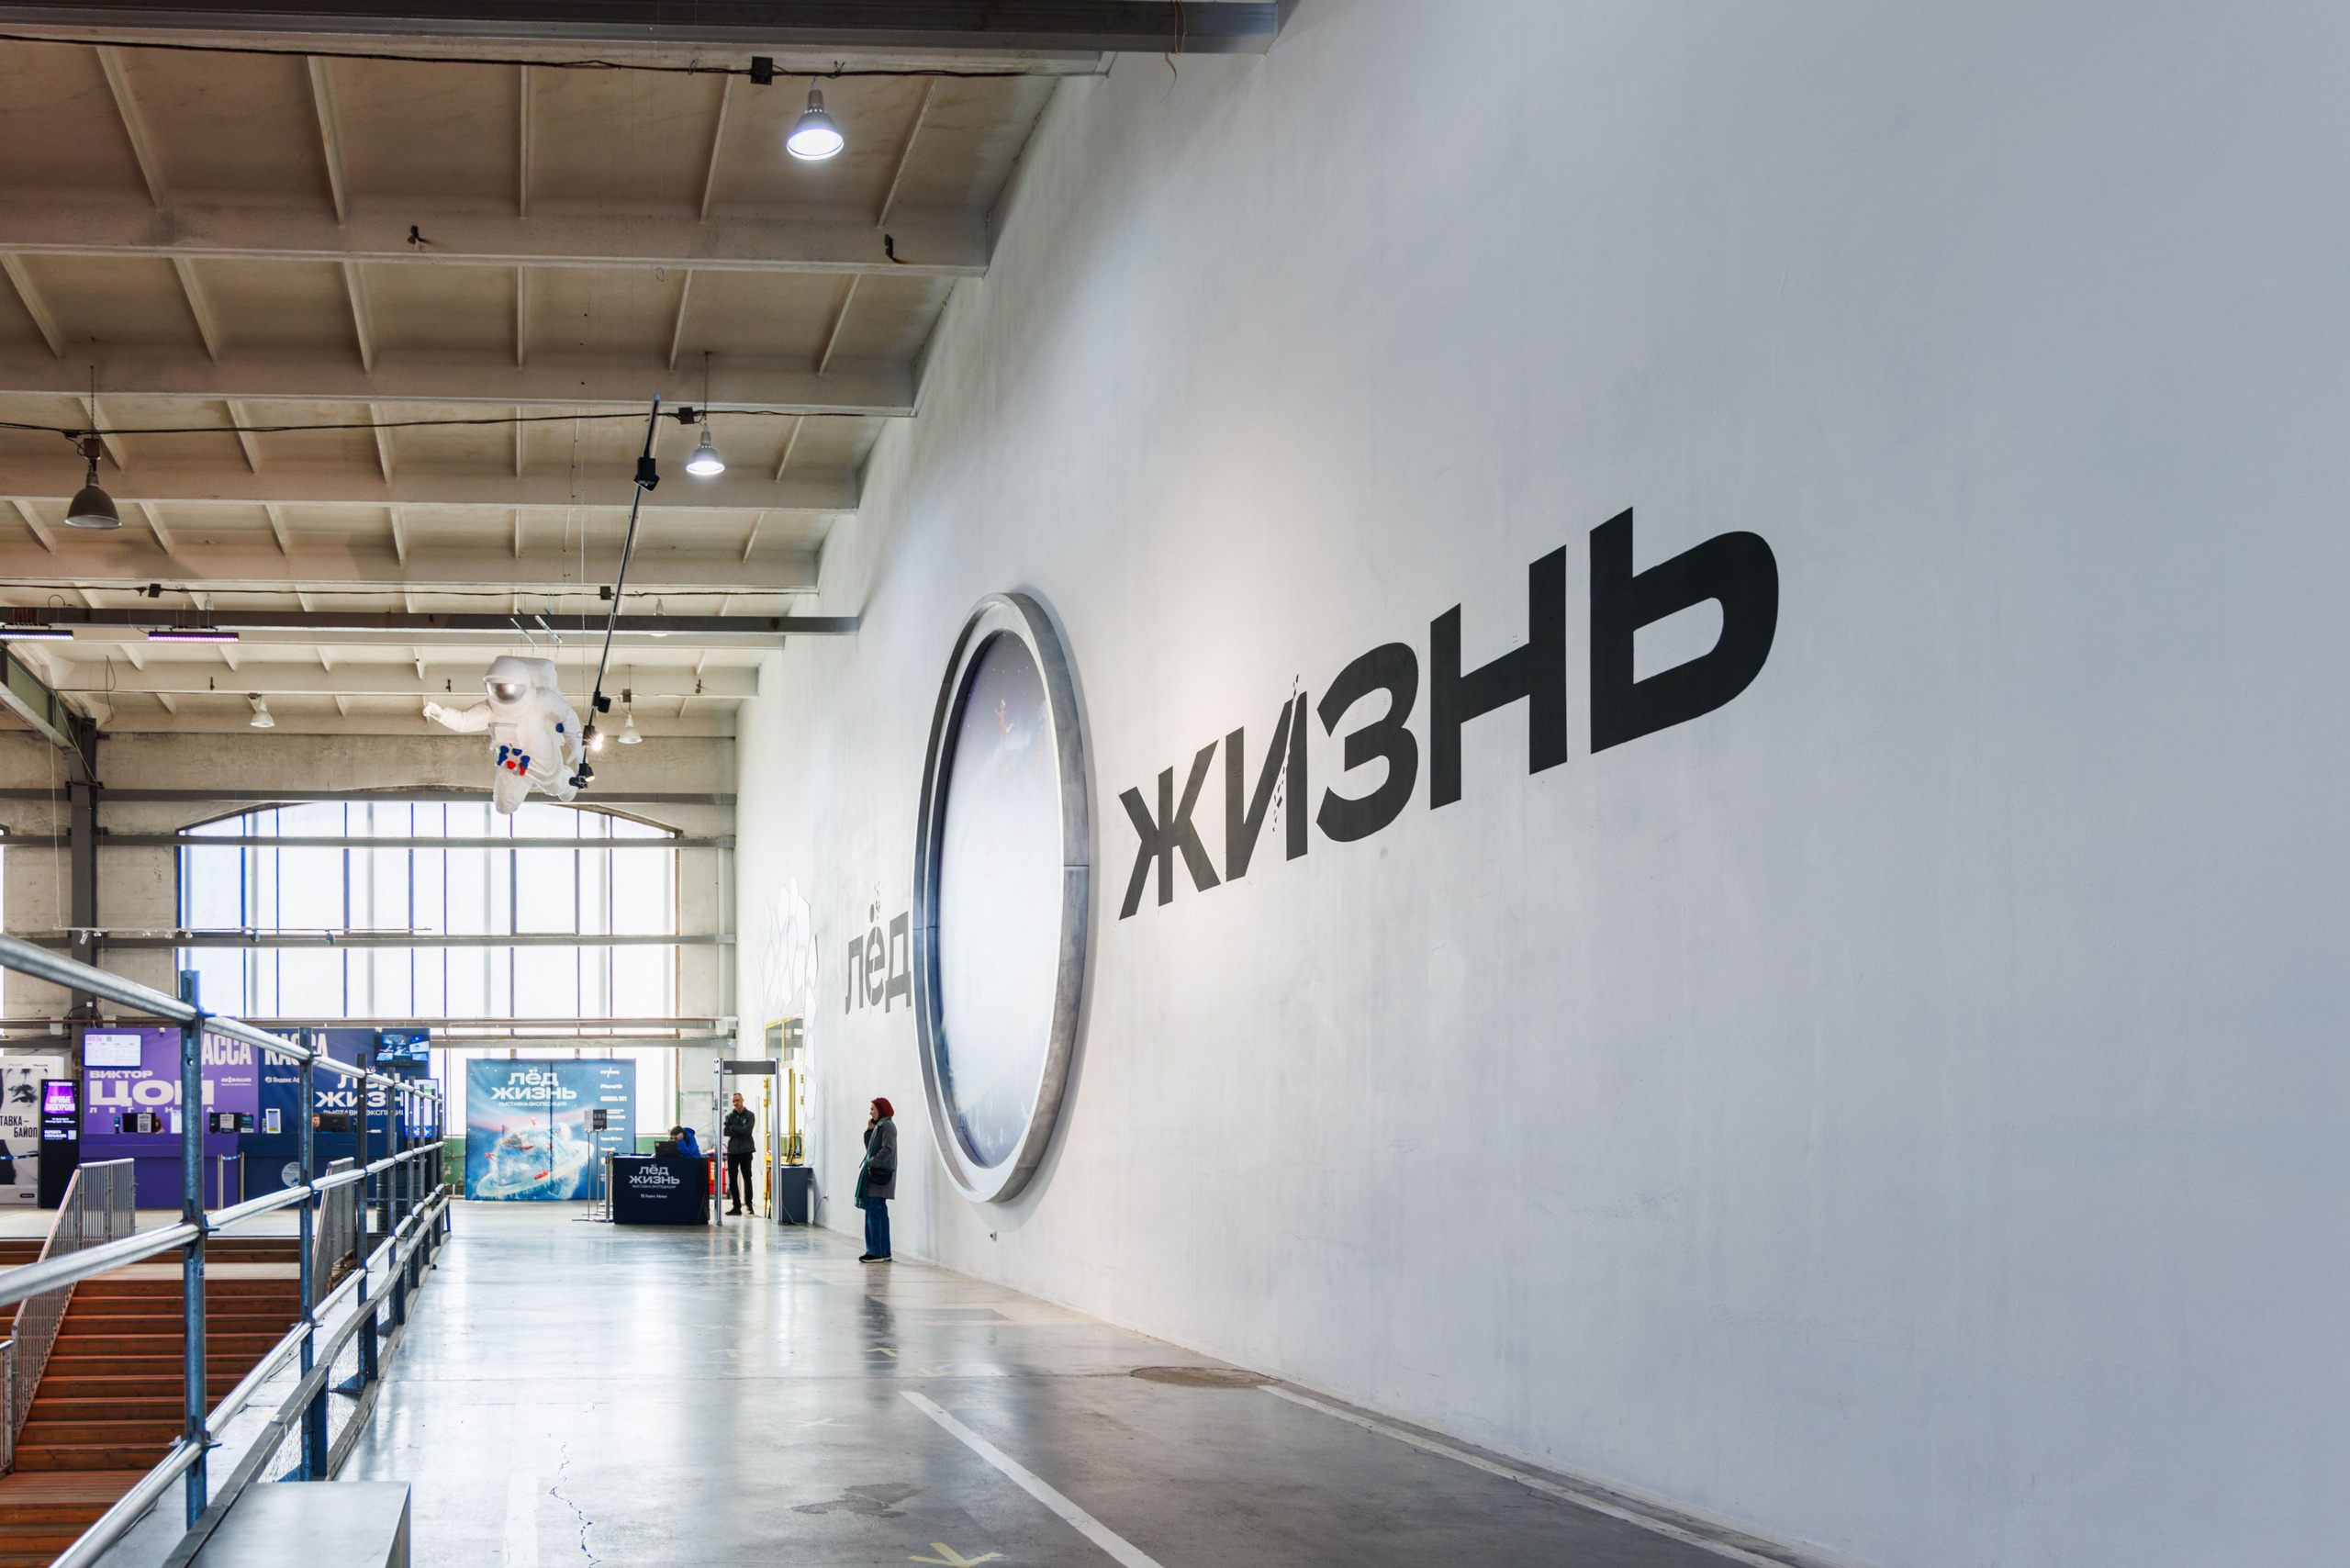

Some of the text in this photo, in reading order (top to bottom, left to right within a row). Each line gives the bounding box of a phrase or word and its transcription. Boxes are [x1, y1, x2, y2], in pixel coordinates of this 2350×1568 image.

[201, 1034, 252, 1065] АССА
[264, 1033, 329, 1066] КАА
[89, 1070, 153, 1079] ВИКТОР
[315, 1091, 404, 1108] ЖИЗН
